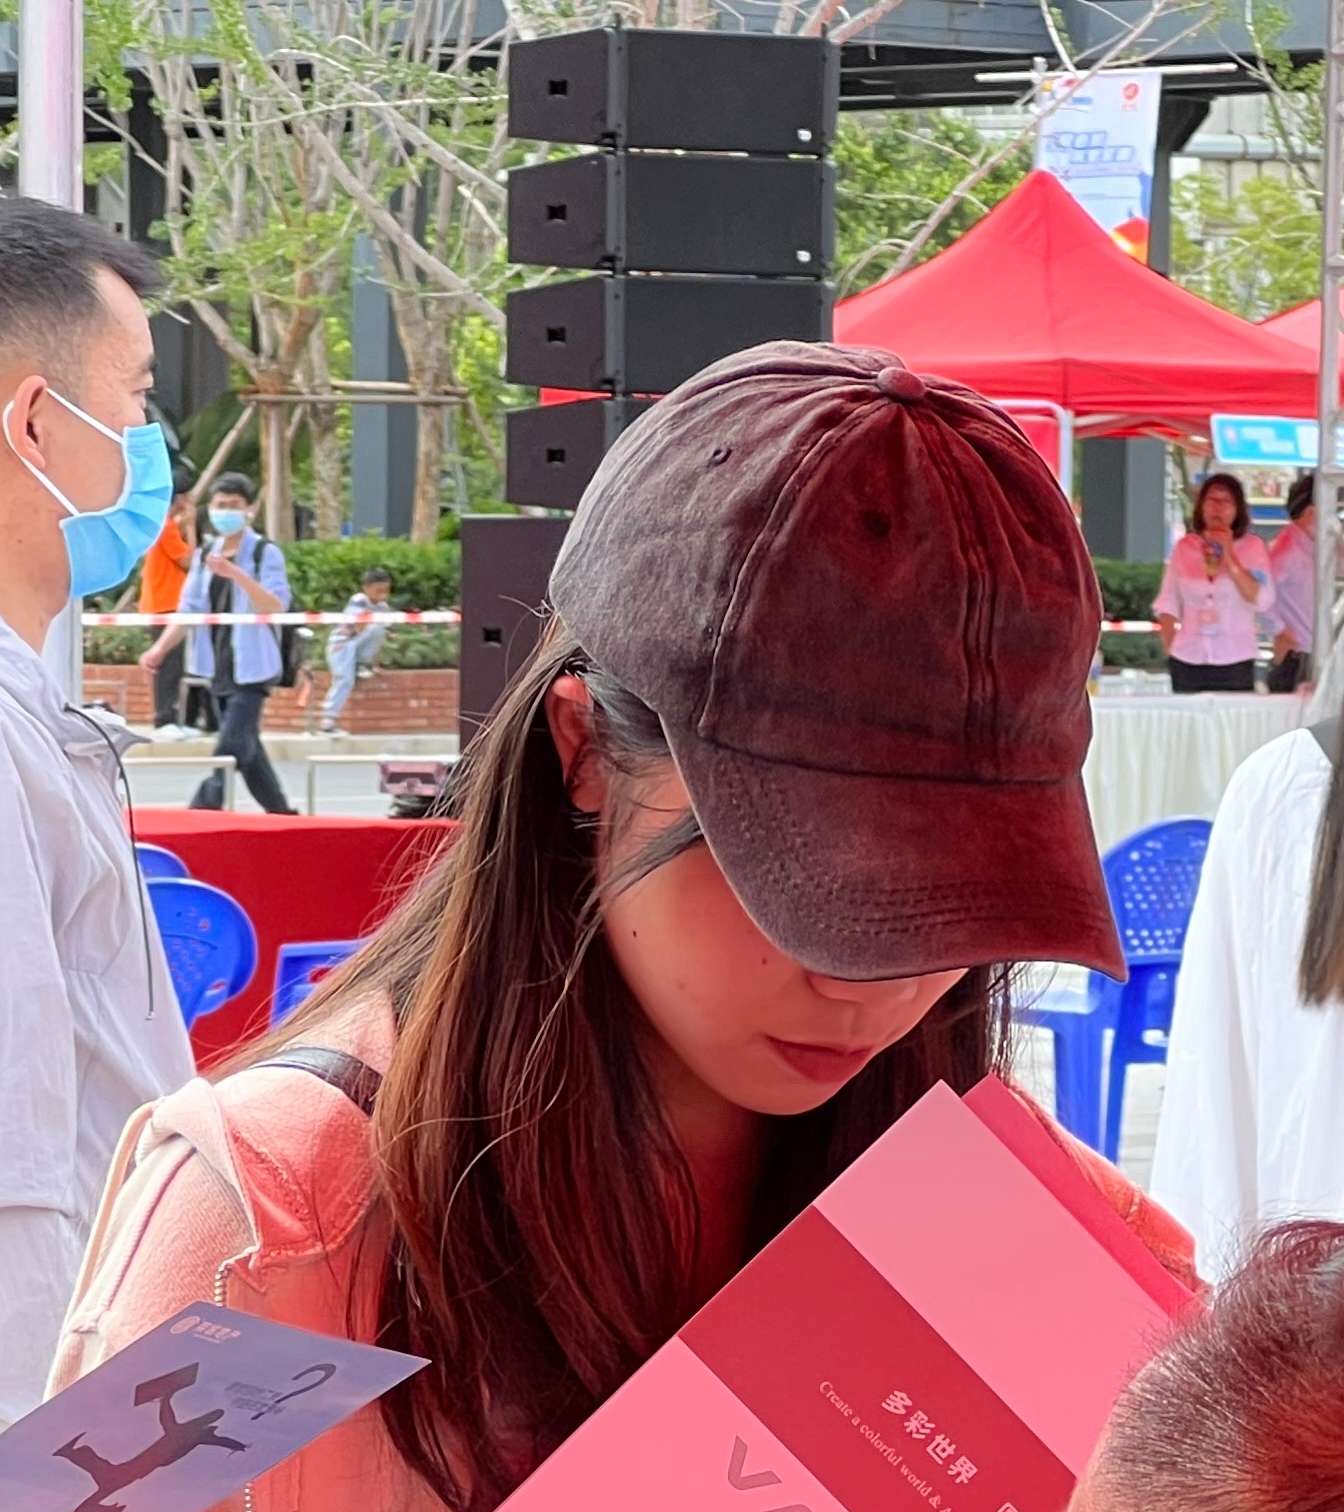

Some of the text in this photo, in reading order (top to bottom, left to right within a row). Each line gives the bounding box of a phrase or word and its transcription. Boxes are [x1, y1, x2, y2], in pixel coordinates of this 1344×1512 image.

[818, 1380, 854, 1418] Create
[859, 1423, 902, 1467] colorful
[900, 1460, 933, 1498] world
[928, 1493, 943, 1510] &
[881, 1389, 979, 1486] 多彩世界
